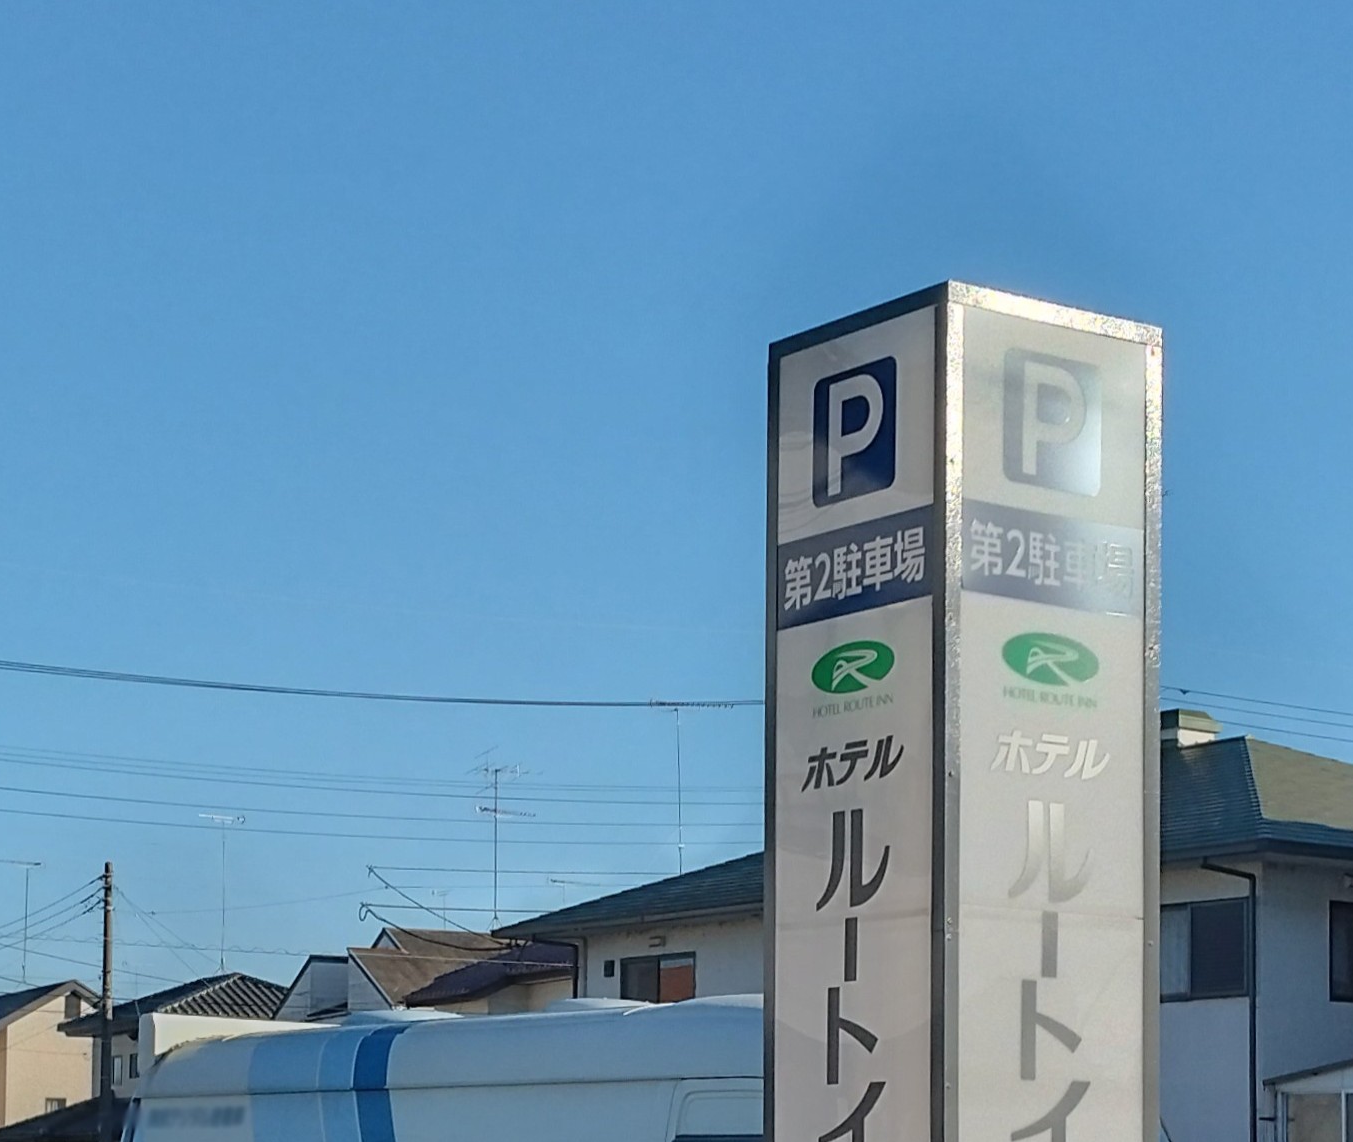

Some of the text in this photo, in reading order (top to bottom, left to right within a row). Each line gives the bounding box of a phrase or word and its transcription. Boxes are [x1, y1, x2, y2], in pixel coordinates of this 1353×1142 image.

[828, 373, 884, 497] P
[1022, 360, 1087, 477] P
[783, 526, 926, 611] 第2駐車場
[970, 518, 1134, 599] 第2駐車場
[812, 692, 895, 719] HOTEL ROUTE INN
[801, 734, 905, 793] ホテル
[990, 730, 1111, 781] ホテル
